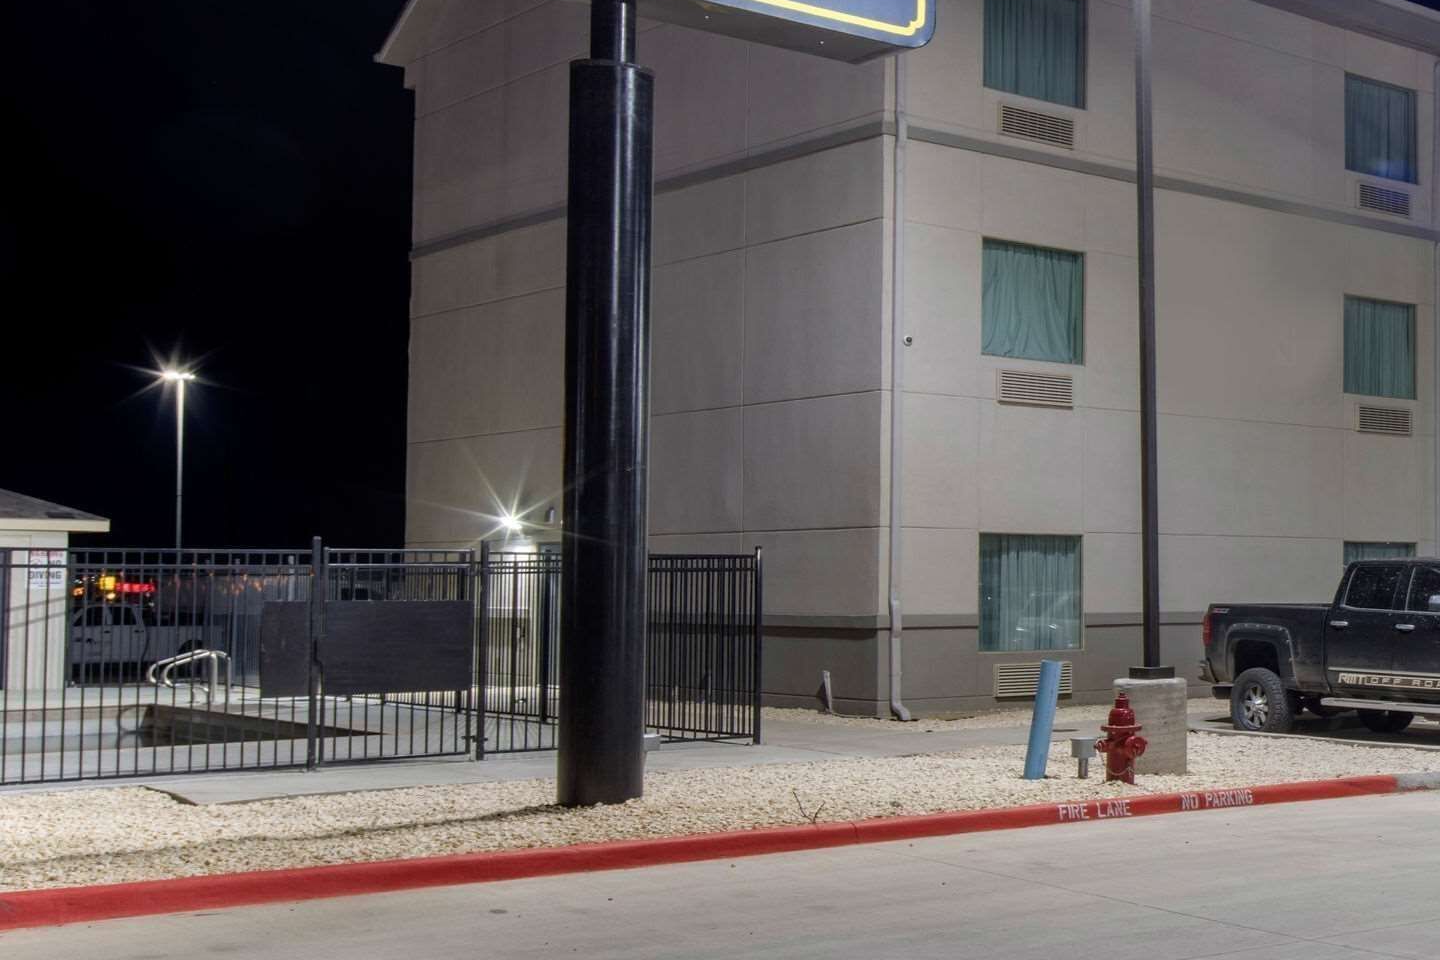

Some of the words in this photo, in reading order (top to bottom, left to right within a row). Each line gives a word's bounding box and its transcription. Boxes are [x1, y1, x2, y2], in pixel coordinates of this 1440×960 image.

[29, 570, 62, 580] DIVNG
[1058, 803, 1090, 821] FIRE
[1096, 799, 1132, 818] LANE
[1180, 793, 1199, 810] NO
[1204, 790, 1254, 807] PARKING
